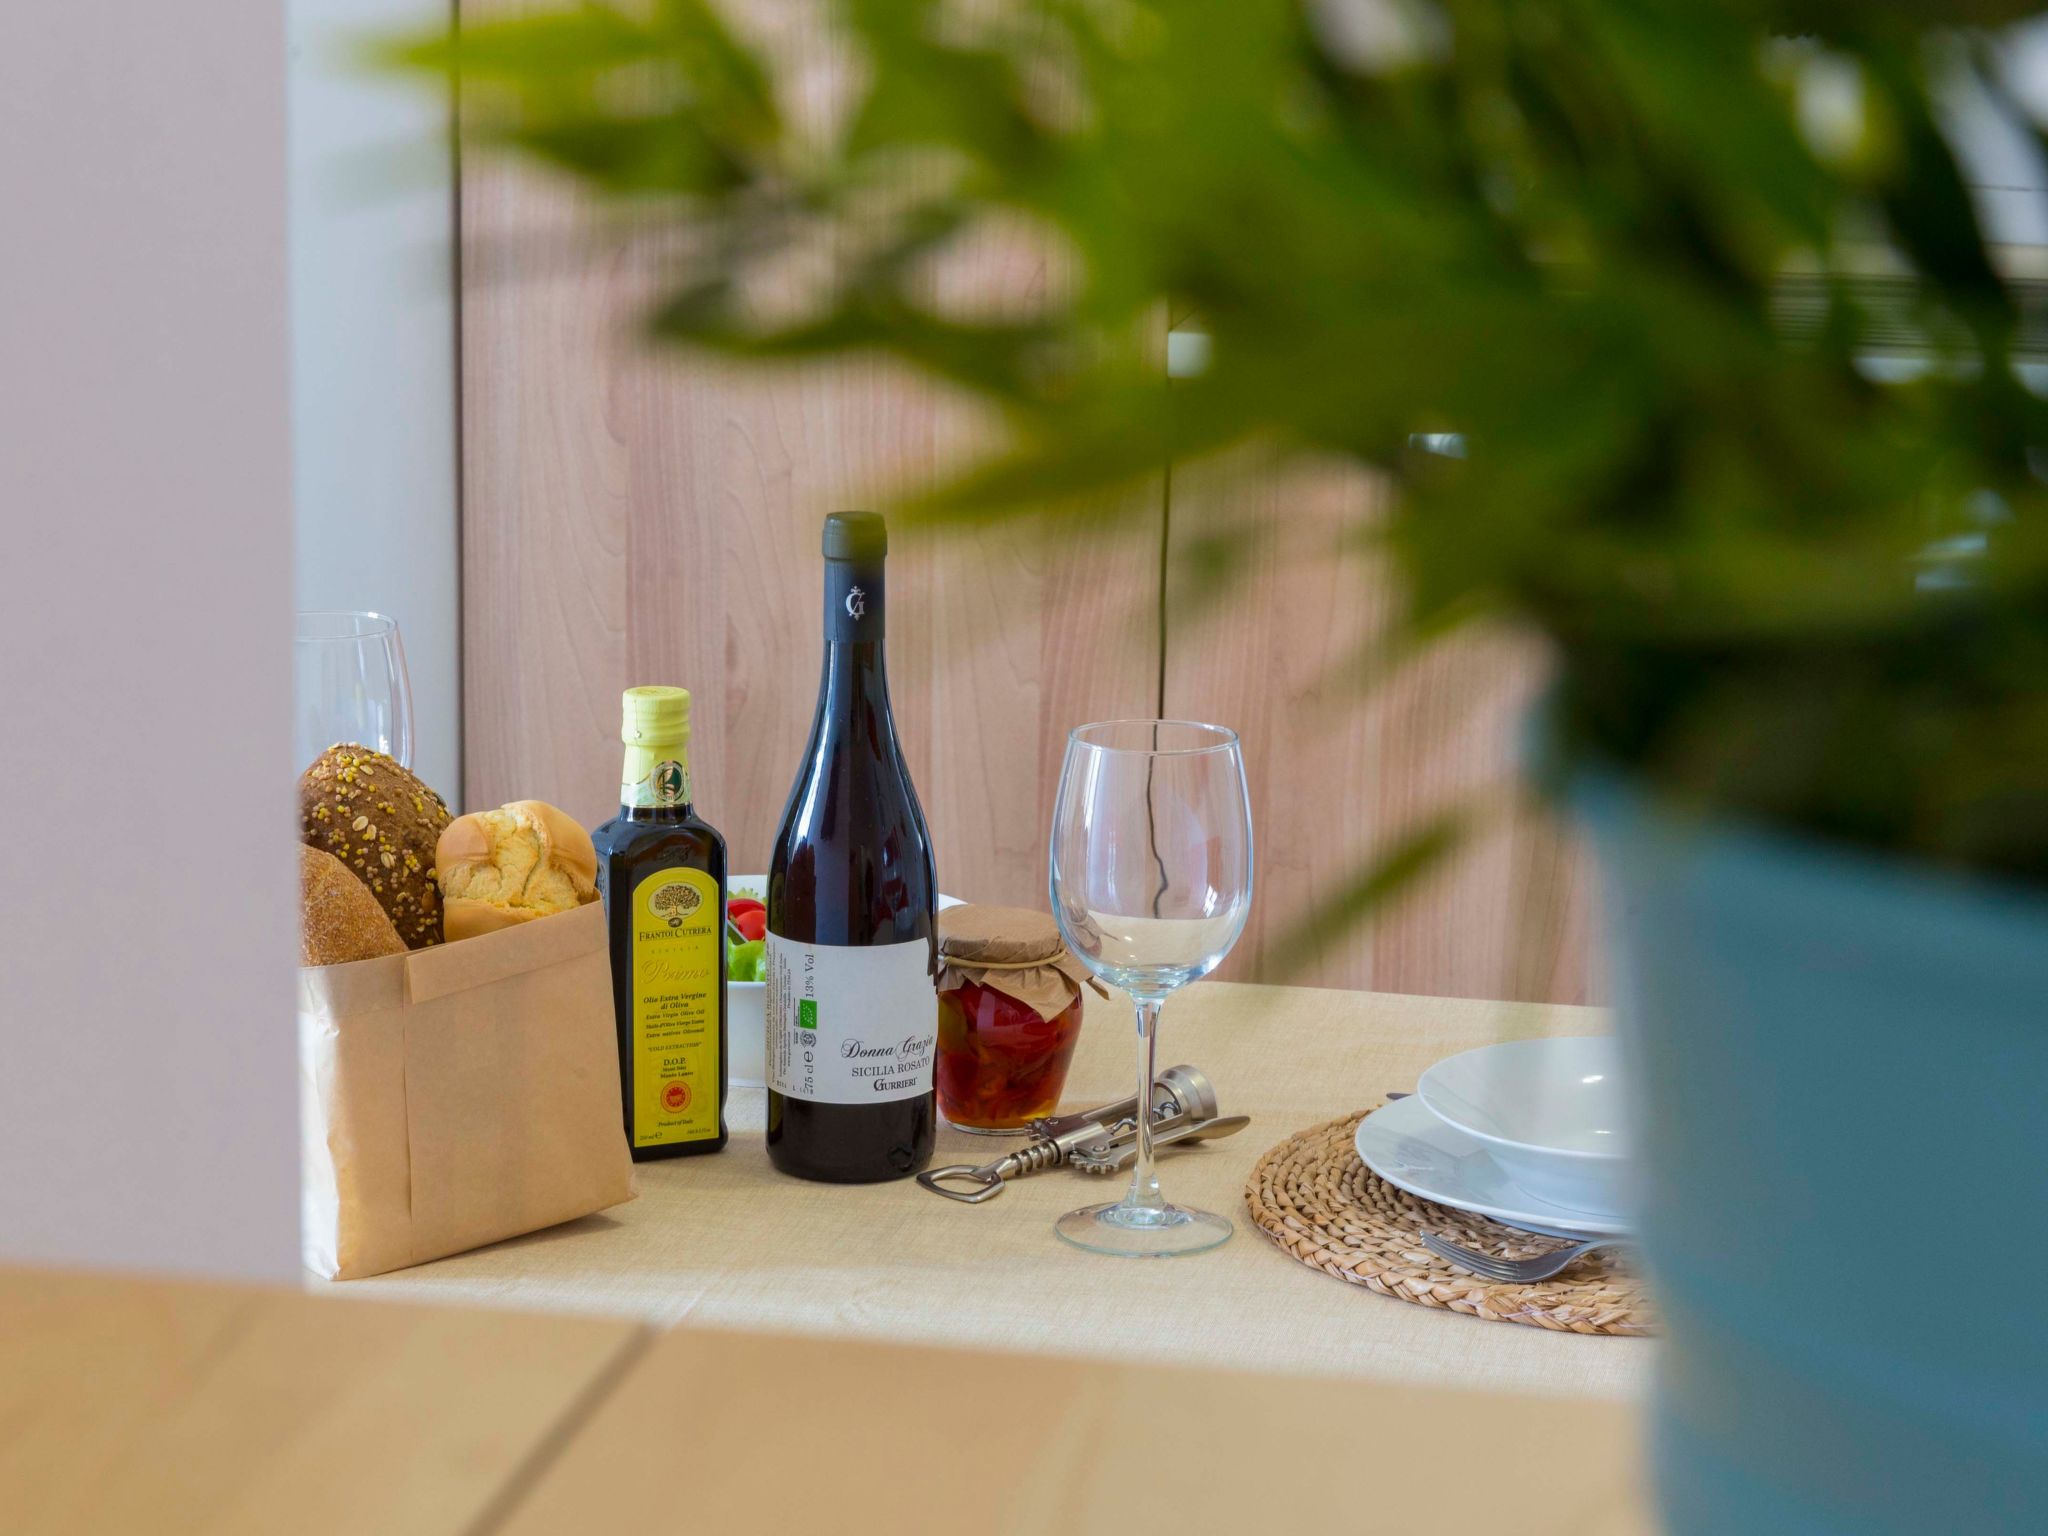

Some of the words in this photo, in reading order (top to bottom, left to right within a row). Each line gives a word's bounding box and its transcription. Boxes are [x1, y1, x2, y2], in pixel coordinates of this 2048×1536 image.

[639, 930, 673, 942] FRANTOI
[675, 927, 712, 938] CUTRERA
[804, 954, 814, 972] Vol
[804, 975, 814, 998] 13%
[643, 996, 658, 1004] Olio
[680, 992, 707, 1001] Vergine
[669, 1001, 689, 1009] Oliva
[841, 1038, 895, 1059] Donna
[804, 1064, 814, 1074] cl
[851, 1065, 895, 1077] SICILIA
[897, 1056, 930, 1073] ROSATO
[804, 1076, 814, 1089] 75
[873, 1078, 917, 1092] GURRIERI
